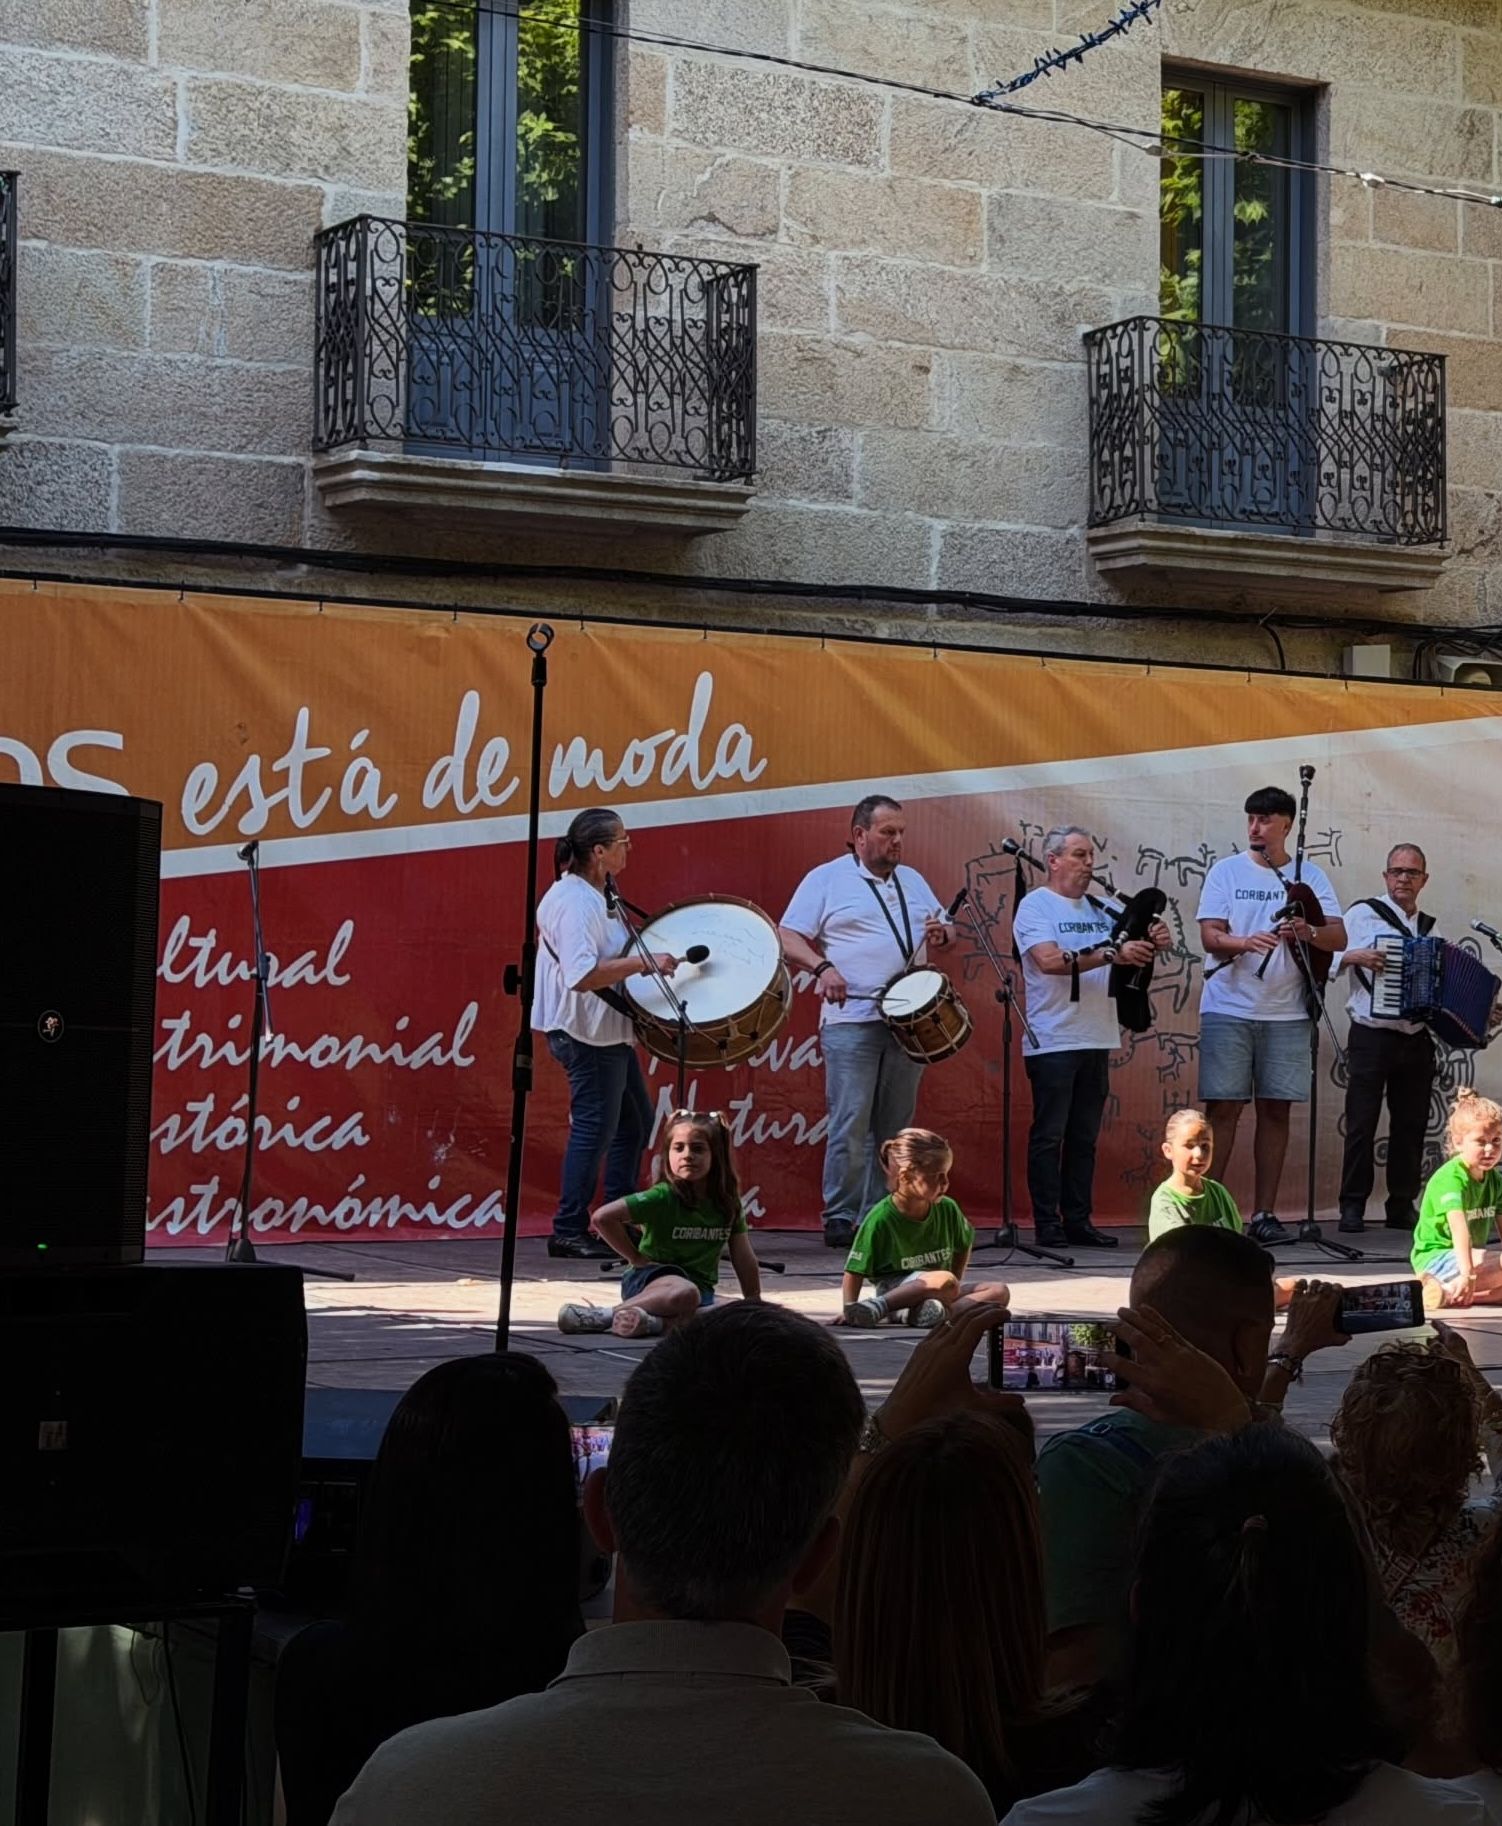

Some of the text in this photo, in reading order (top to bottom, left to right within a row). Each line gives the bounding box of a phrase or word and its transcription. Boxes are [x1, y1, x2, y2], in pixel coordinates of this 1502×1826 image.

[181, 707, 398, 836] está
[422, 690, 520, 814] de
[549, 671, 768, 798] moda
[1235, 888, 1285, 902] CORIBANT
[153, 1001, 479, 1071] trimonial
[150, 1093, 370, 1154] stórica
[671, 1226, 732, 1240] CORIBANTES
